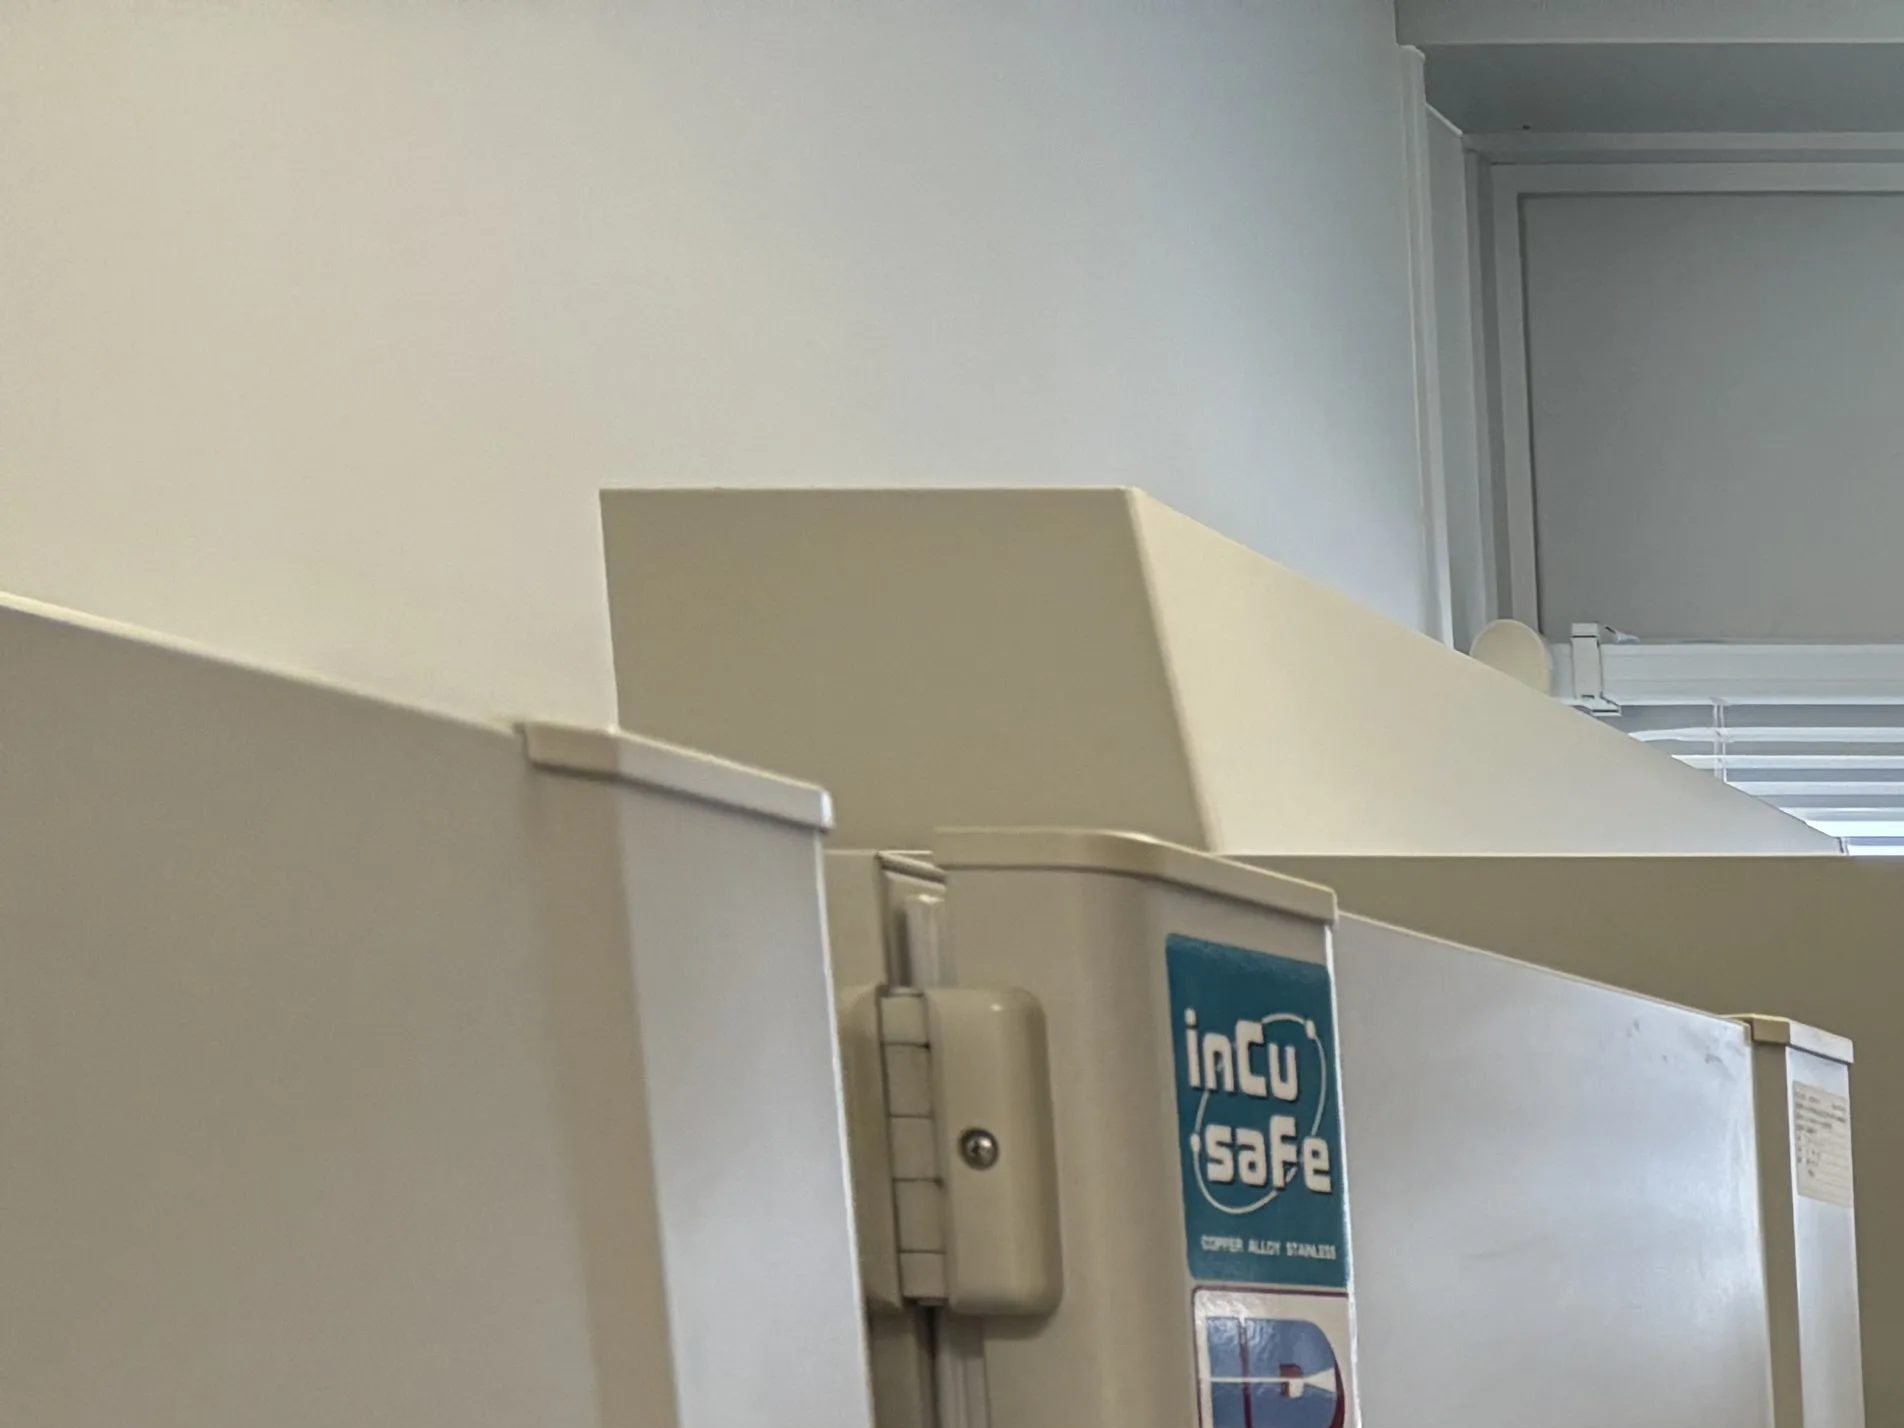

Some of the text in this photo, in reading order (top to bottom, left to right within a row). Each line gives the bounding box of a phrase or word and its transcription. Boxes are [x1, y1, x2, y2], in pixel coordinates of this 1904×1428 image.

[1200, 1235, 1337, 1261] COPPER ALLOY STAINLESS
